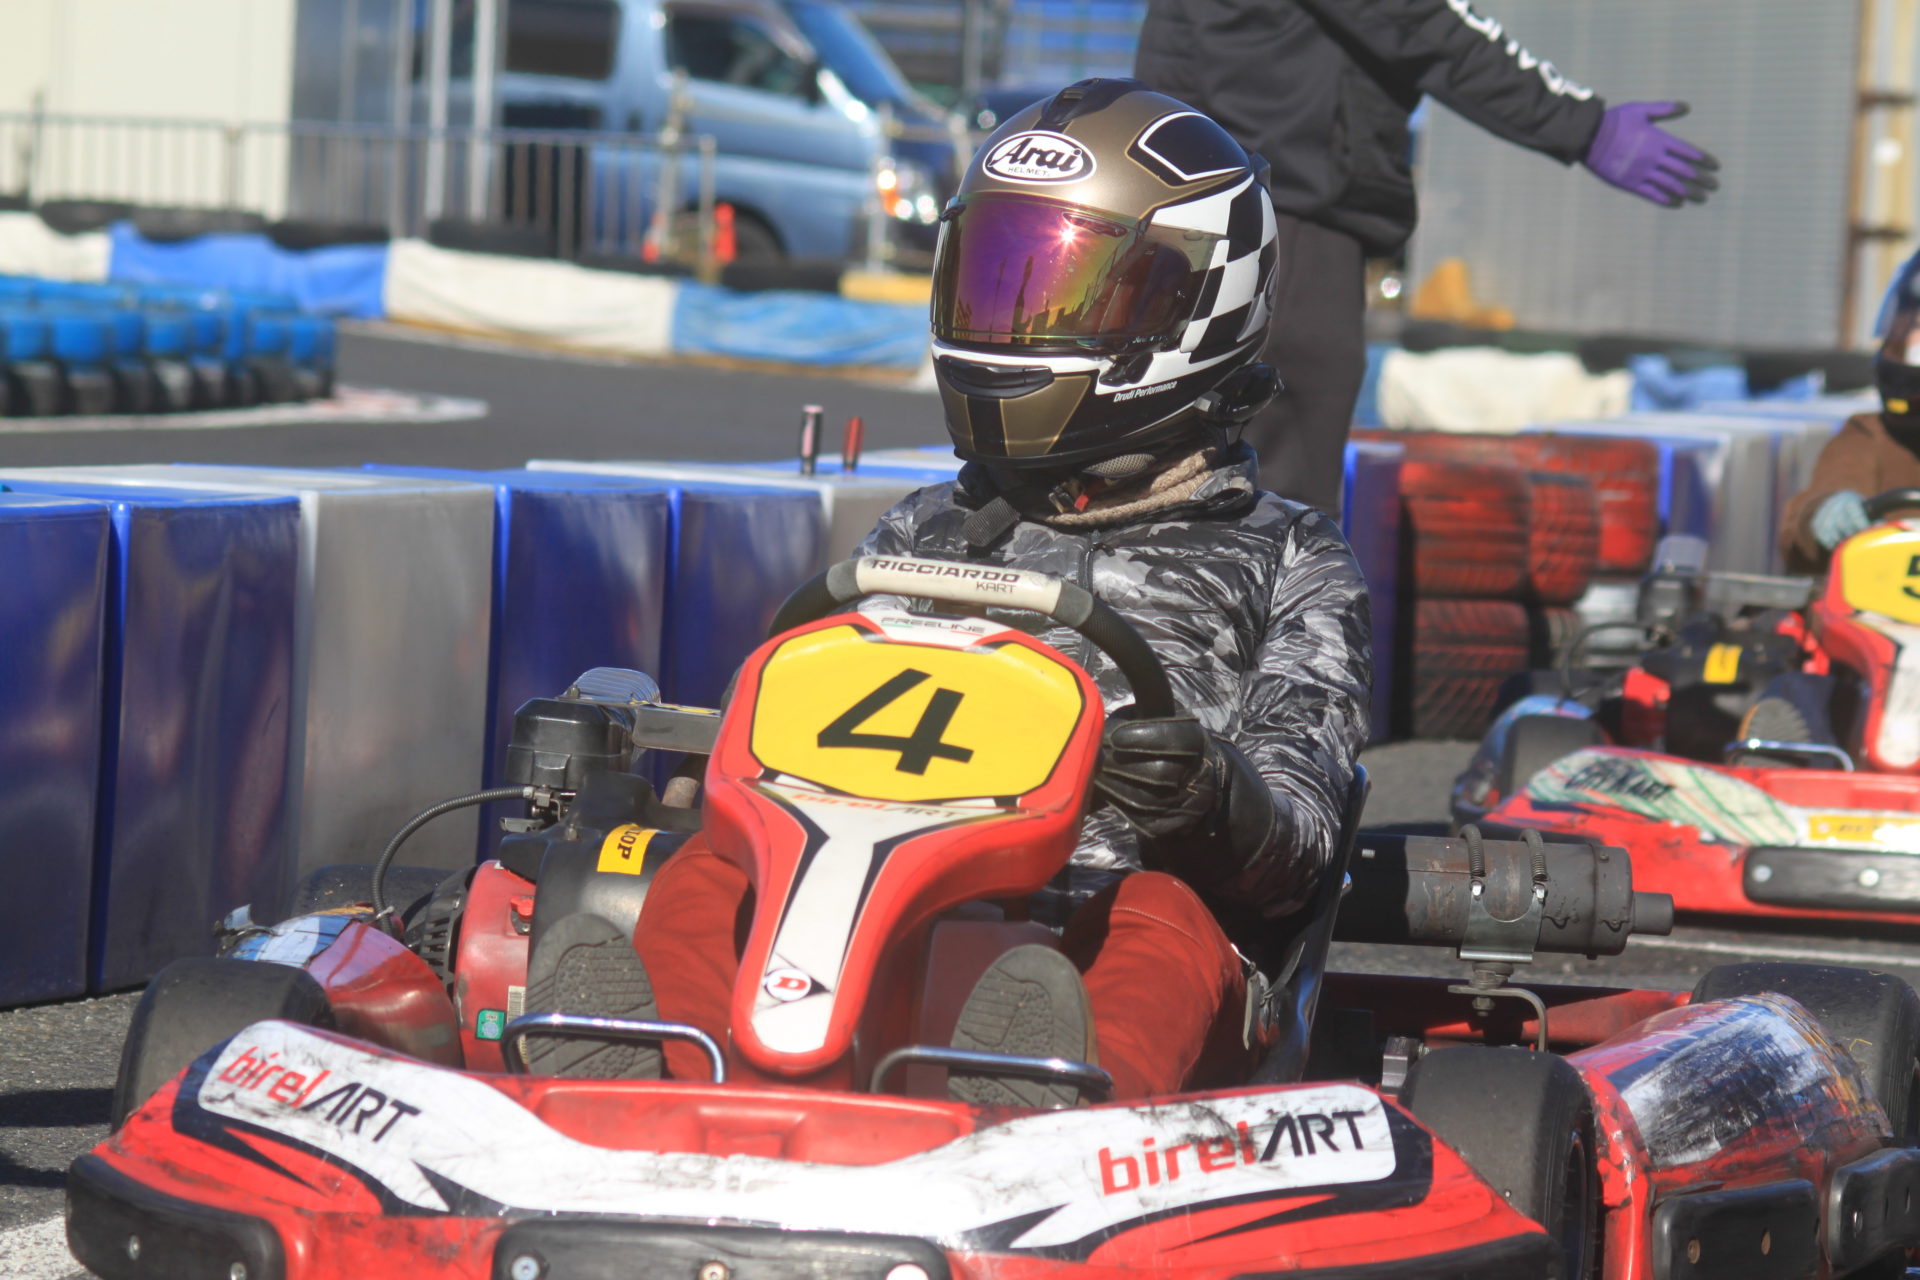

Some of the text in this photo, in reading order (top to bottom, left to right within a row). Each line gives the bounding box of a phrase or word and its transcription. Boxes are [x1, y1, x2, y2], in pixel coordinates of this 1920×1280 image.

[987, 137, 1082, 172] Arai
[1113, 380, 1178, 403] Drudi Performance
[871, 558, 1021, 584] RICCIARDO
[975, 581, 1018, 594] KART
[880, 616, 986, 634] FREELINE
[817, 668, 974, 776] 4
